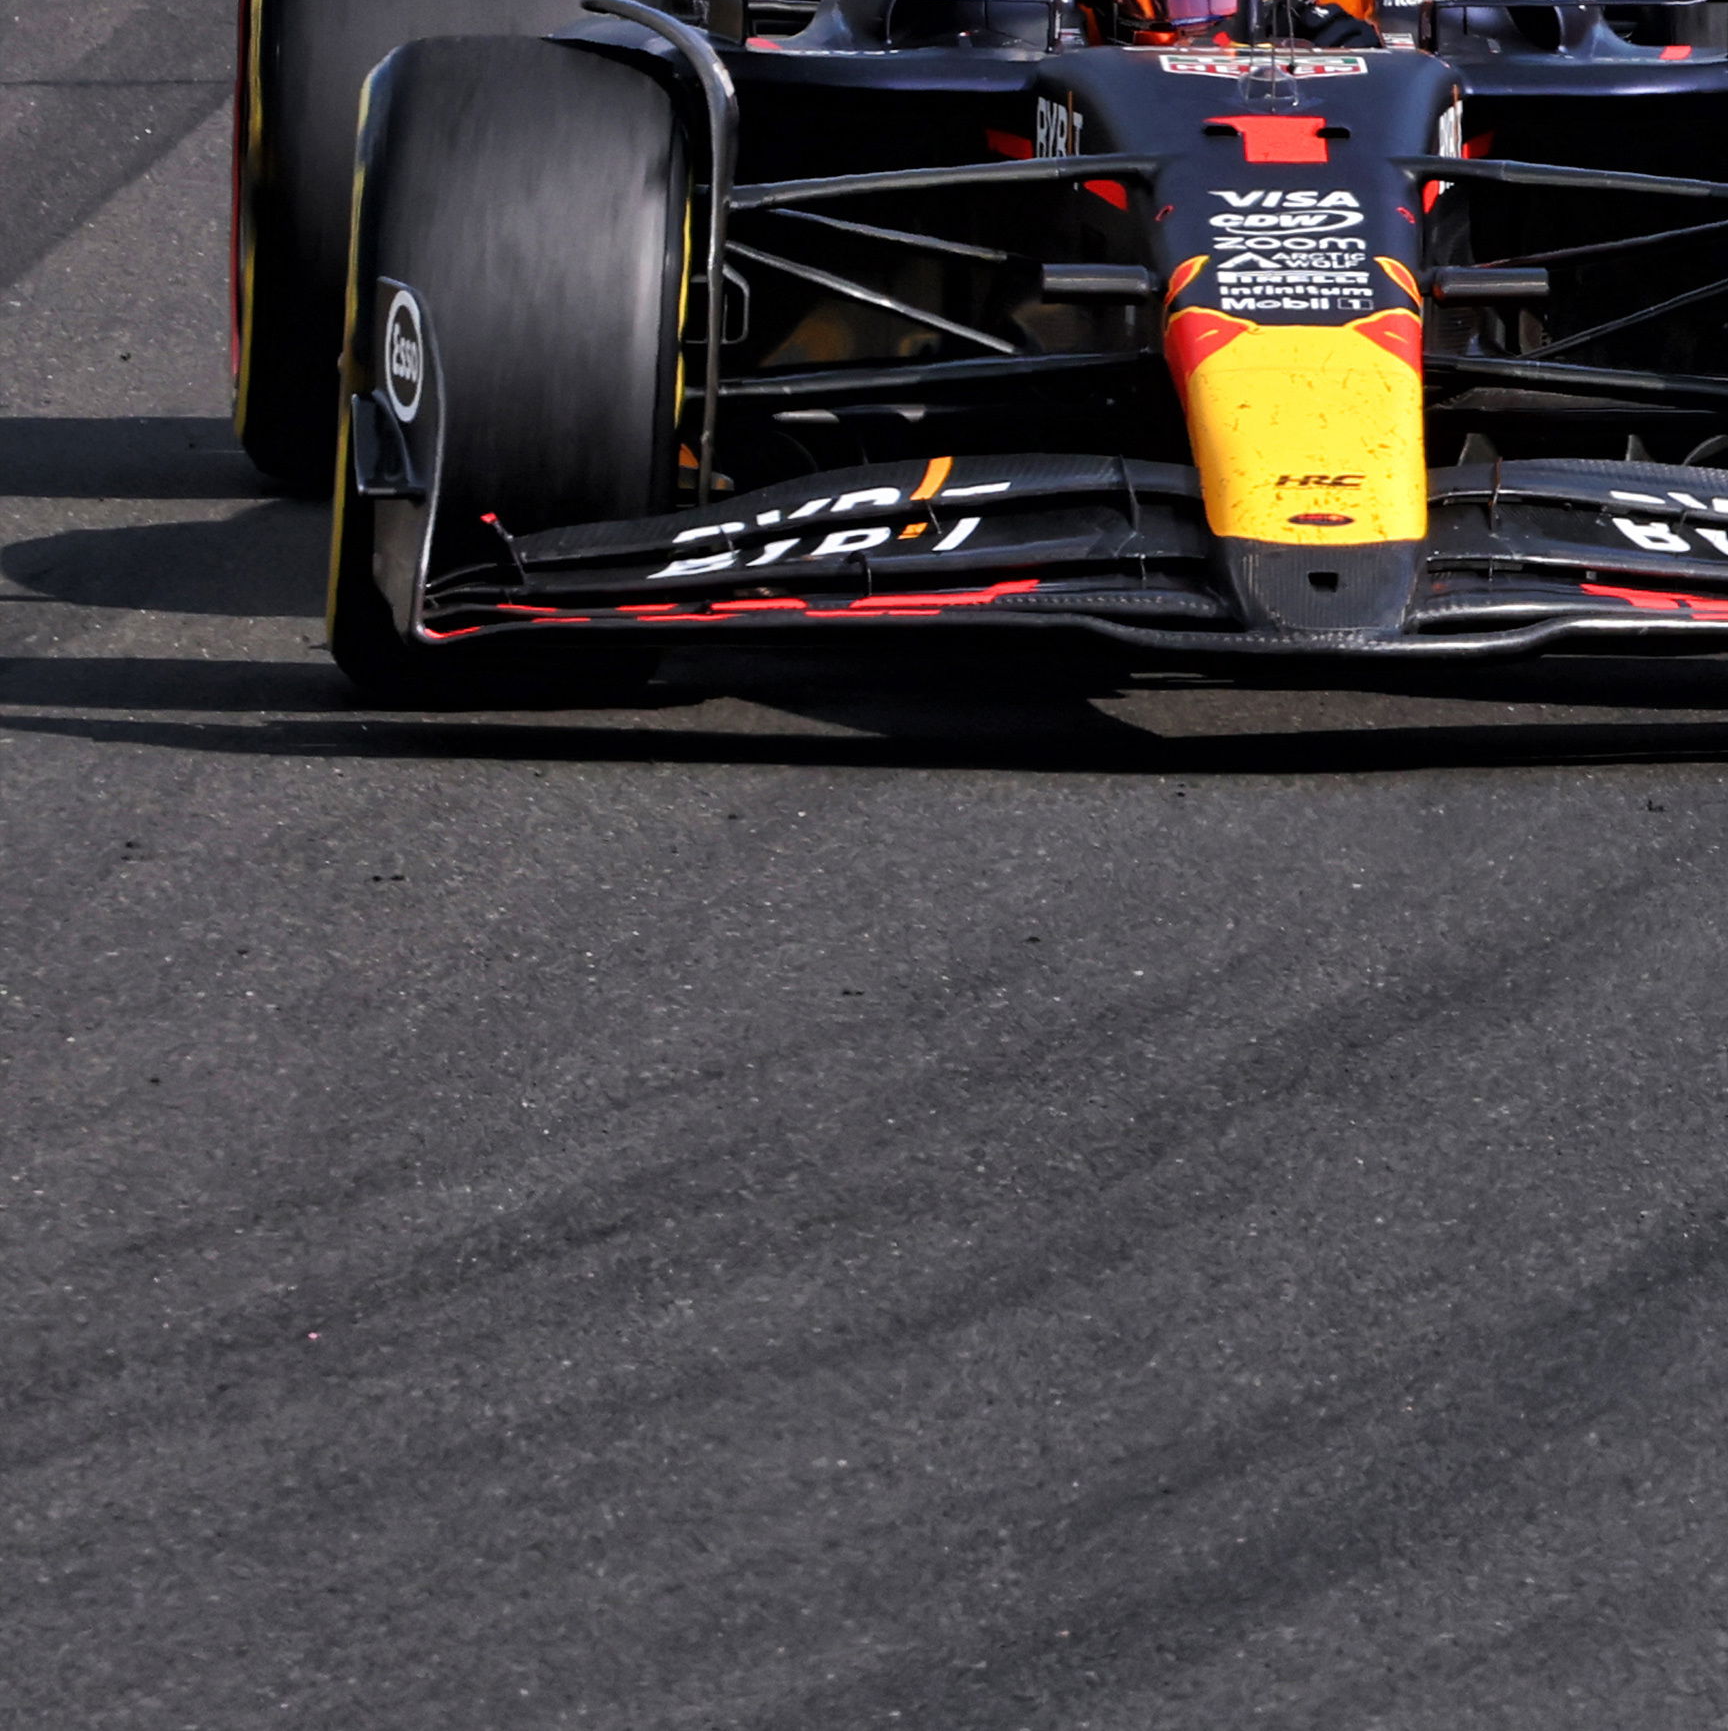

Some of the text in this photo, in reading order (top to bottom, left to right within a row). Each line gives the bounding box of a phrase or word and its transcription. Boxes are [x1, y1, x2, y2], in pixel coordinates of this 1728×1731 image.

[1206, 189, 1361, 208] VISA
[1209, 212, 1330, 228] CDW
[1212, 236, 1367, 251] zoom
[1271, 252, 1367, 262] ARCTIC
[1284, 259, 1360, 269] WOLF
[1216, 270, 1370, 284] PIRELLI
[1220, 297, 1331, 310] Mobil
[1275, 475, 1367, 487] HRC
